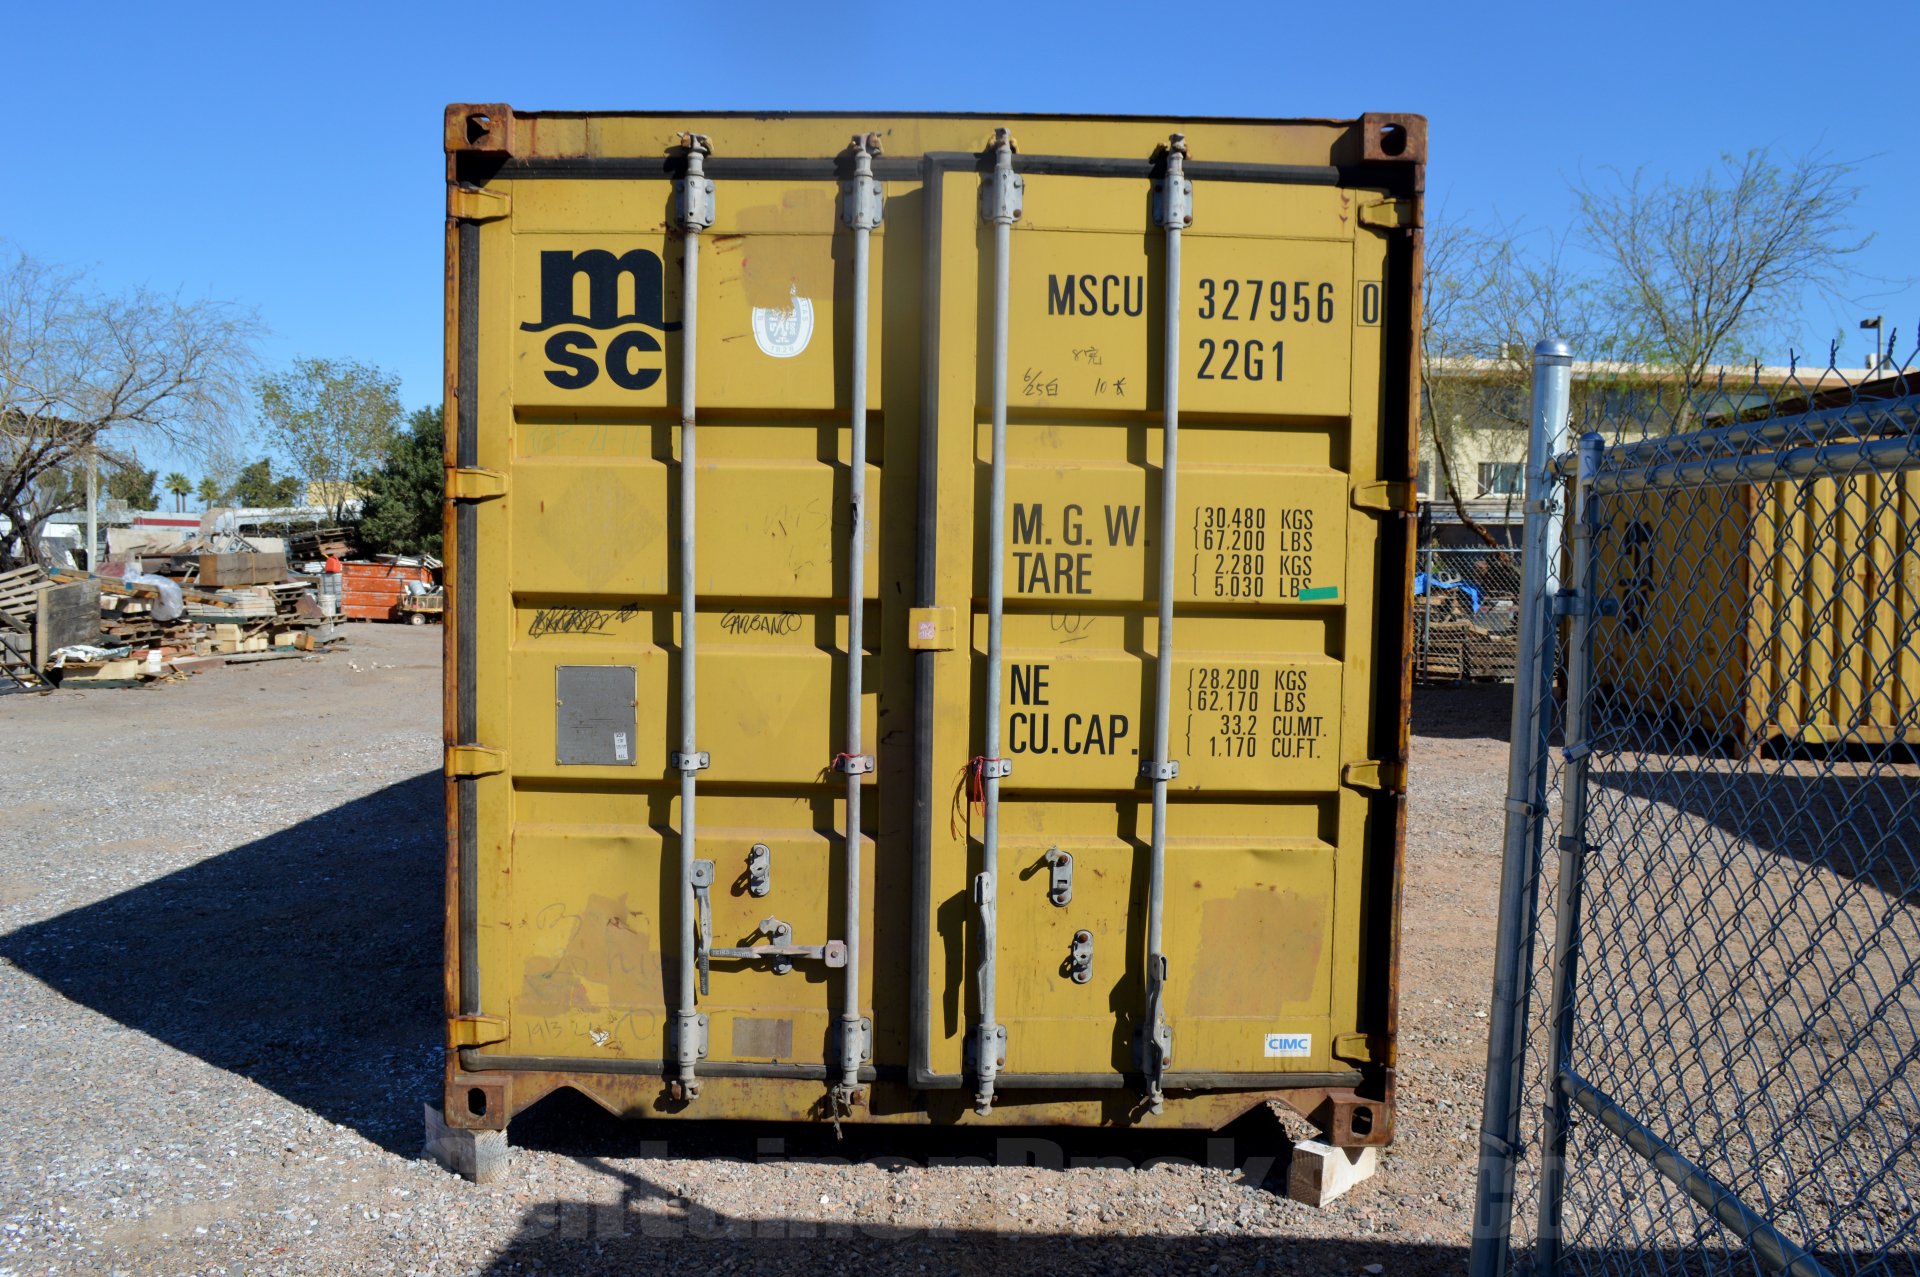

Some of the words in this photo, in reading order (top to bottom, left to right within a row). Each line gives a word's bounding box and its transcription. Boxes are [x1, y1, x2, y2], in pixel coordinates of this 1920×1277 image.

[1048, 274, 1144, 317] MSCU
[1198, 278, 1334, 323] 327956
[1362, 283, 1379, 324] 0
[1197, 339, 1284, 381] 22G1
[1204, 507, 1265, 528] 30,480
[1281, 509, 1313, 530] KGS
[1204, 529, 1264, 551] 67,200
[1280, 531, 1312, 552] LBS
[1012, 552, 1092, 595] TARE
[1215, 554, 1263, 575] 2,280
[1280, 555, 1312, 576] KGS
[1010, 664, 1050, 706] NE
[1198, 668, 1259, 690] 28,200
[1275, 670, 1307, 691] KGS
[1197, 690, 1258, 711] 62,170
[1273, 692, 1306, 712] LBS
[1008, 711, 1140, 756] CU.CAP.
[1220, 715, 1257, 735] 33.2
[1272, 716, 1327, 737] CU.MT.
[1209, 737, 1256, 757] 1,170
[1271, 737, 1320, 758] CU.FT.
[1268, 1038, 1308, 1050] CIMC
